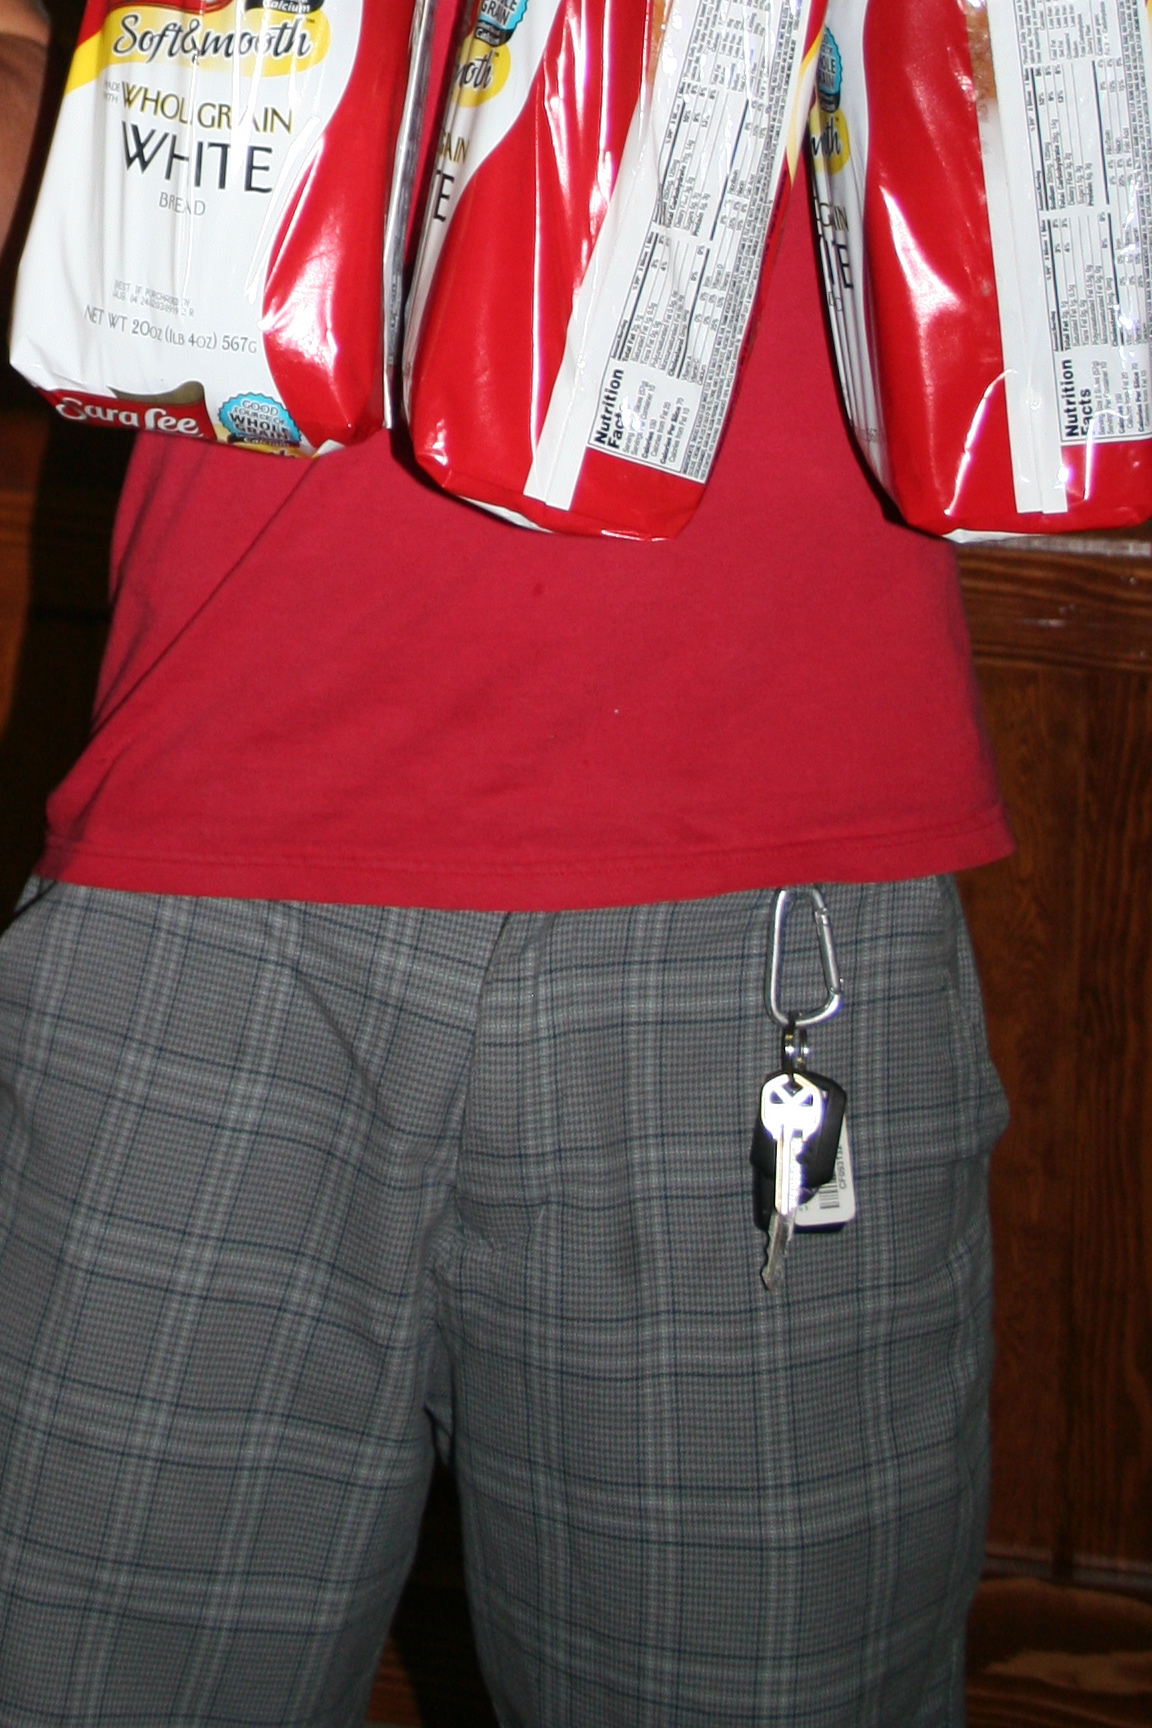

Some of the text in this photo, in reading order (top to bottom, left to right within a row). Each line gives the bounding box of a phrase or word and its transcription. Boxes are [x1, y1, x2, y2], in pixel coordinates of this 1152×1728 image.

[121, 120, 273, 194] WHITE
[158, 191, 207, 217] BREAD
[85, 304, 105, 324] NET
[108, 312, 128, 333] WT
[242, 400, 279, 416] GOOD
[594, 369, 624, 444] Nutrition
[1059, 359, 1080, 438] Nutrition
